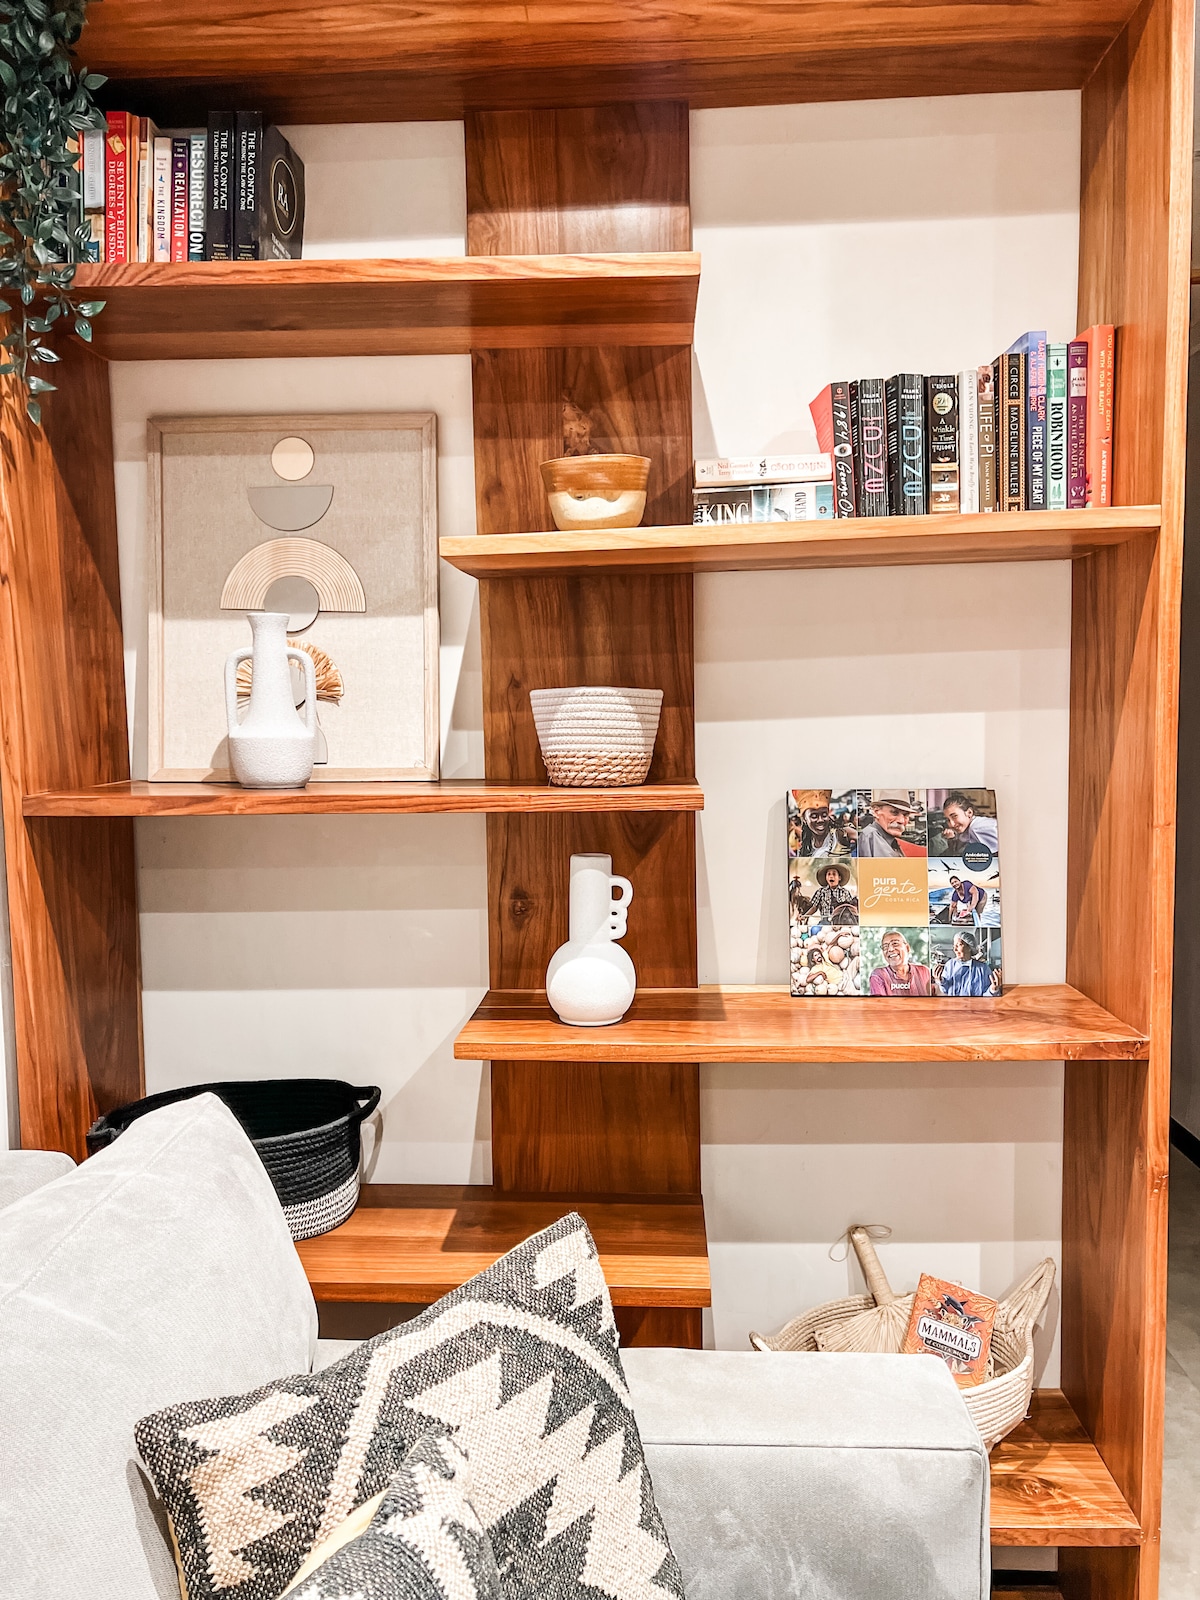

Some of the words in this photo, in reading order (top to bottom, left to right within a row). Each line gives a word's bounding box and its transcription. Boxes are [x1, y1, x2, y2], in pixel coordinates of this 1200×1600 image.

[220, 130, 228, 149] THE
[248, 130, 256, 150] THE
[220, 151, 228, 165] RA
[247, 152, 256, 165] RA
[108, 161, 116, 209] DEGREES
[190, 139, 205, 254] RESURRECTION
[220, 166, 228, 211] CONTACT
[246, 166, 255, 212] CONTACT
[107, 210, 116, 220] of
[116, 161, 125, 257] SEVENTY-EIGHT
[157, 199, 165, 239] KINGDOM
[174, 172, 185, 237] REALIZATION
[1010, 367, 1018, 397] CIRCE
[1038, 360, 1046, 394] HIGGINS
[833, 402, 849, 440] 1984
[980, 403, 993, 432] LIFE
[1038, 395, 1046, 421] CLARK
[1050, 402, 1064, 443] ROBIN
[932, 425, 955, 433] Wrinkle
[1010, 407, 1018, 458] MADELINE
[1032, 426, 1042, 451] PIECE
[980, 444, 993, 457] PI
[1032, 452, 1042, 462] OF
[1050, 446, 1064, 481] HOOD
[1071, 443, 1079, 479] PAUPER
[836, 461, 852, 497] George
[1010, 461, 1018, 494] MILLER
[1032, 464, 1043, 477] MY
[1032, 479, 1044, 504] HEART
[701, 502, 749, 525] KING
[863, 879, 923, 909] gente
[872, 877, 897, 887] pura
[890, 982, 910, 991] pucci
[921, 1322, 977, 1353] MAMMALS
